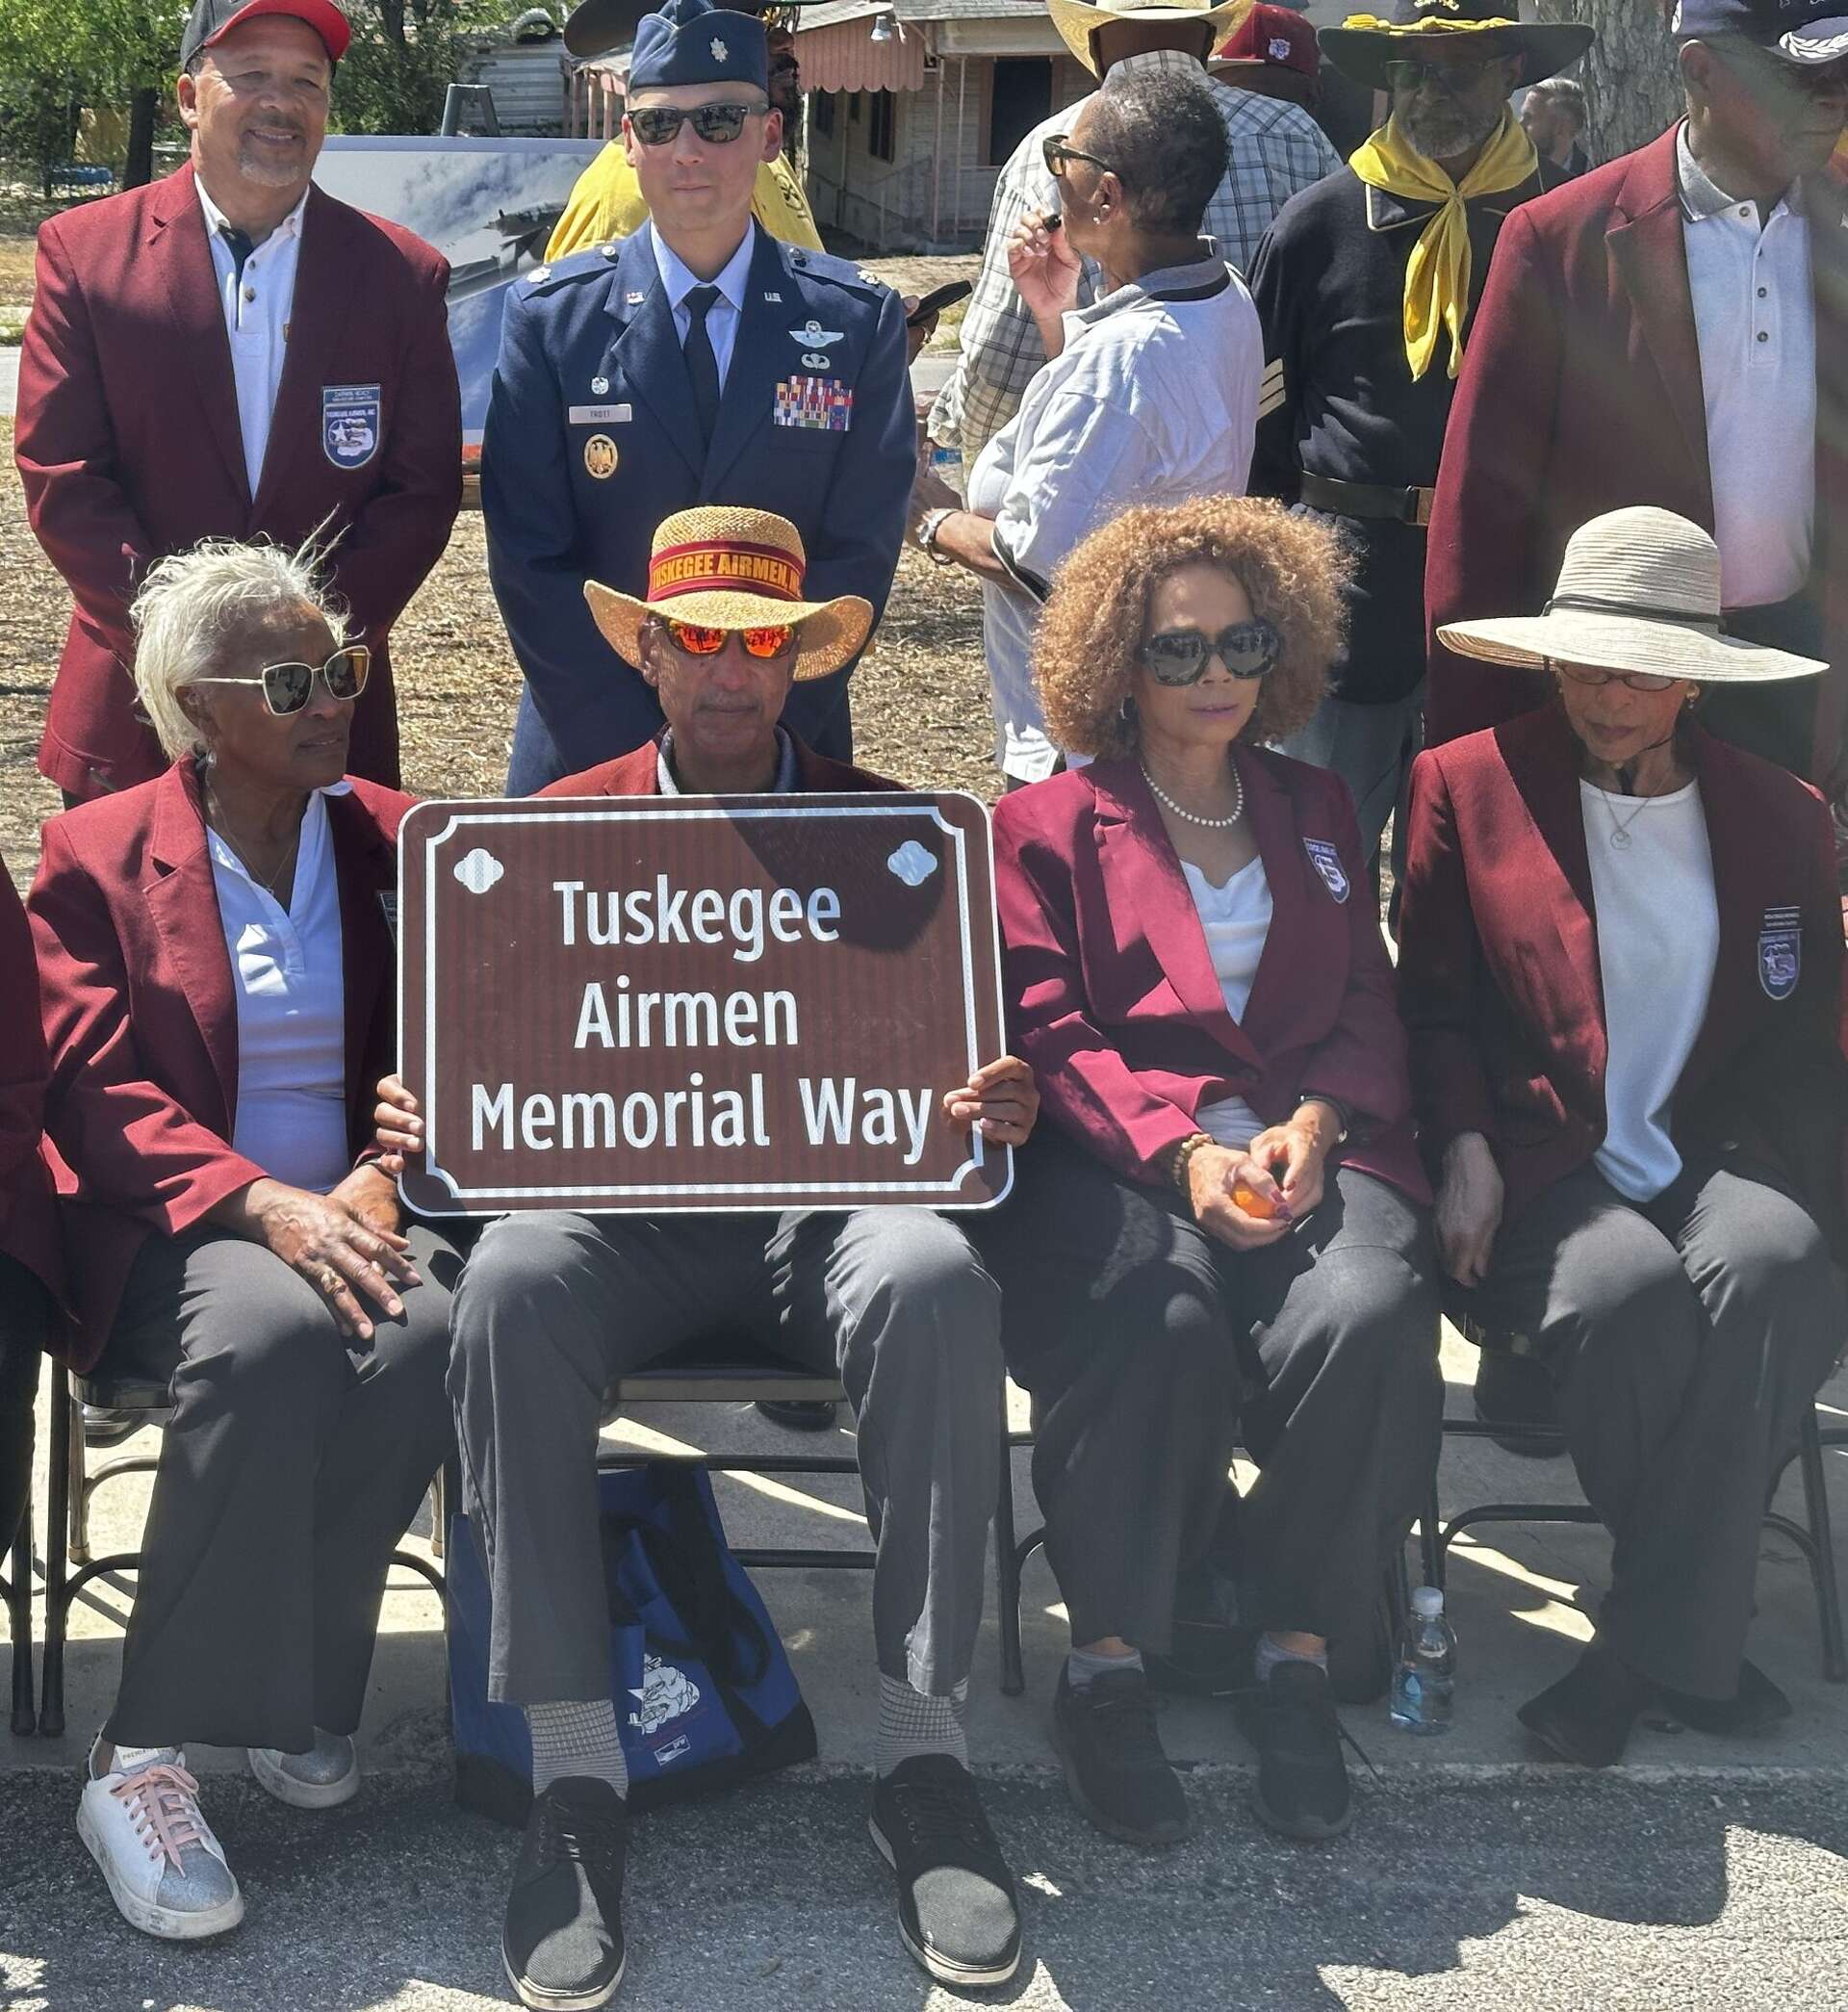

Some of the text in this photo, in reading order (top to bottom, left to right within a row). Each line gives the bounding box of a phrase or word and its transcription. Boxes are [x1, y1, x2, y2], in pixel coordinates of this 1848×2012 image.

[553, 874, 840, 962] Tuskegee
[575, 975, 798, 1048] Airmen
[473, 1072, 932, 1165] Memorial Way
